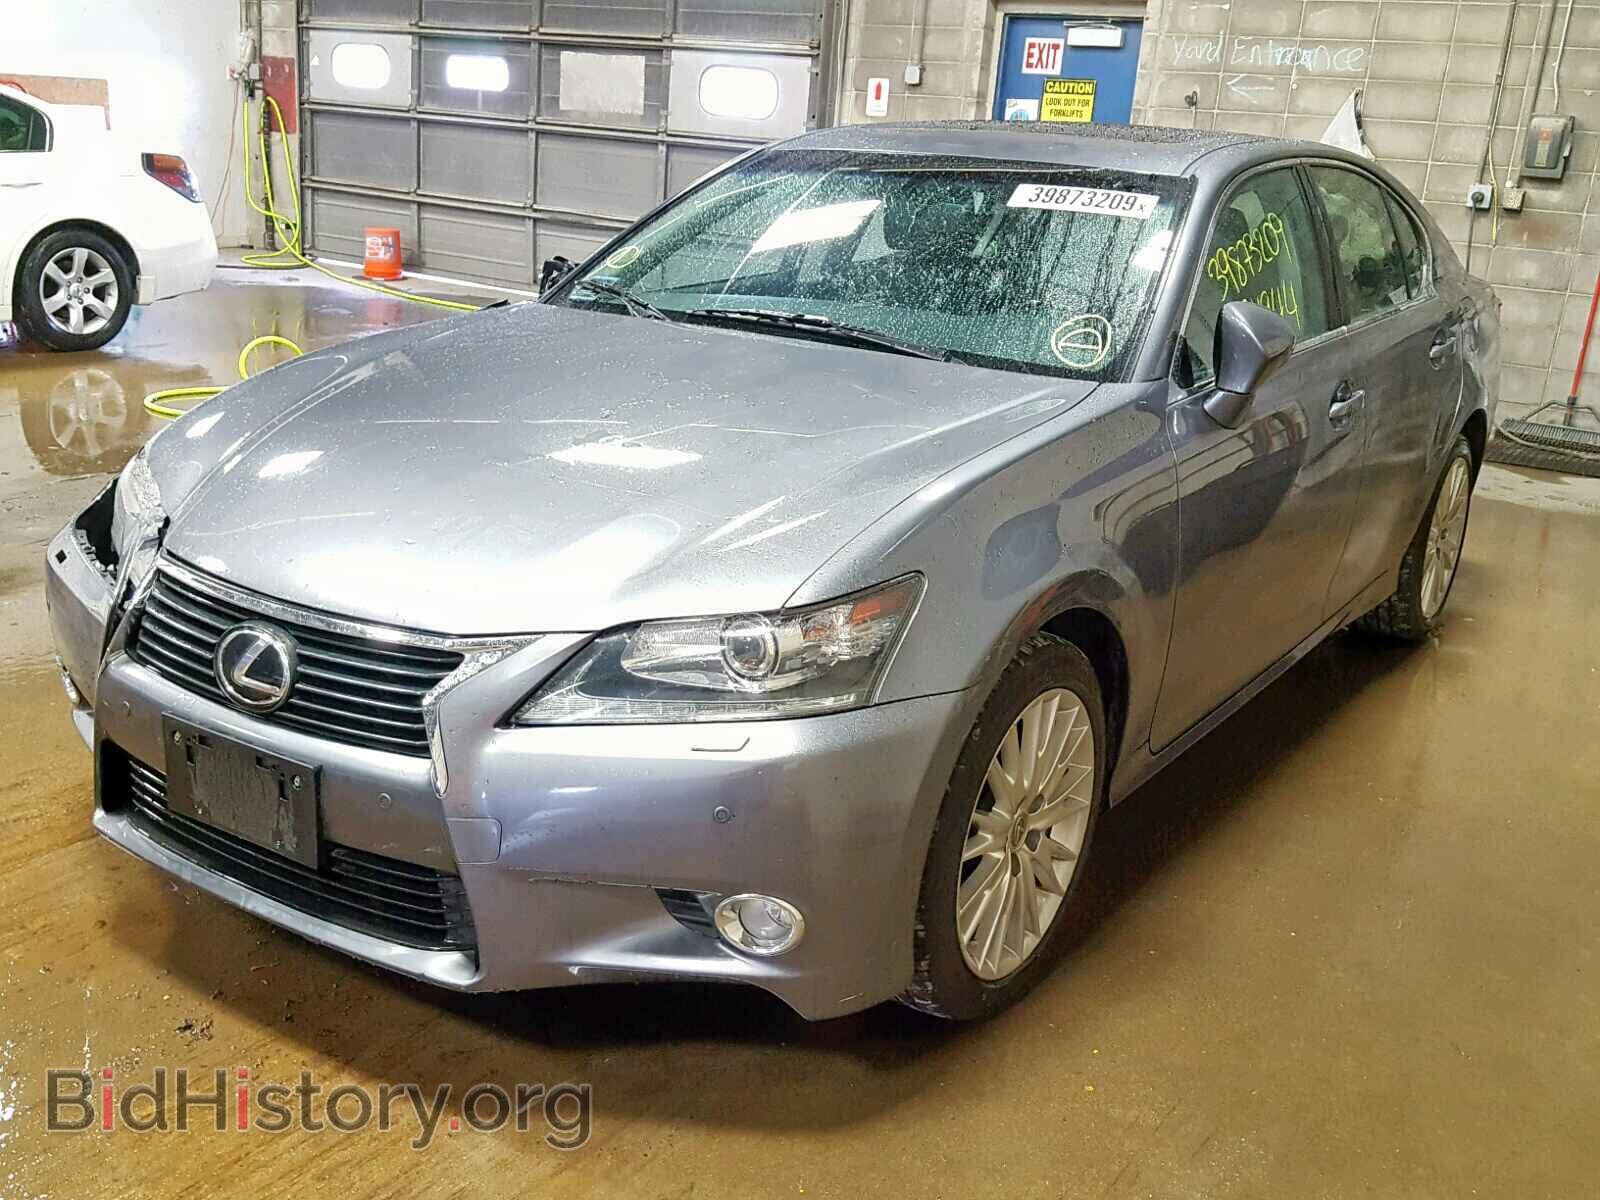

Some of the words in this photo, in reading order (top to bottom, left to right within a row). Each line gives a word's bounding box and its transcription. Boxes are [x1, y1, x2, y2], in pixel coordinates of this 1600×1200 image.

[1025, 41, 1061, 70] EXIT
[1173, 30, 1224, 65] Yard
[1046, 81, 1093, 94] CAUTION
[1045, 97, 1061, 106] LOOK
[1063, 98, 1076, 107] OUT
[1077, 98, 1091, 107] FOR
[1049, 108, 1084, 118] FORKLIFTS
[1028, 186, 1138, 211] 39873209
[1208, 212, 1293, 302] 39873209
